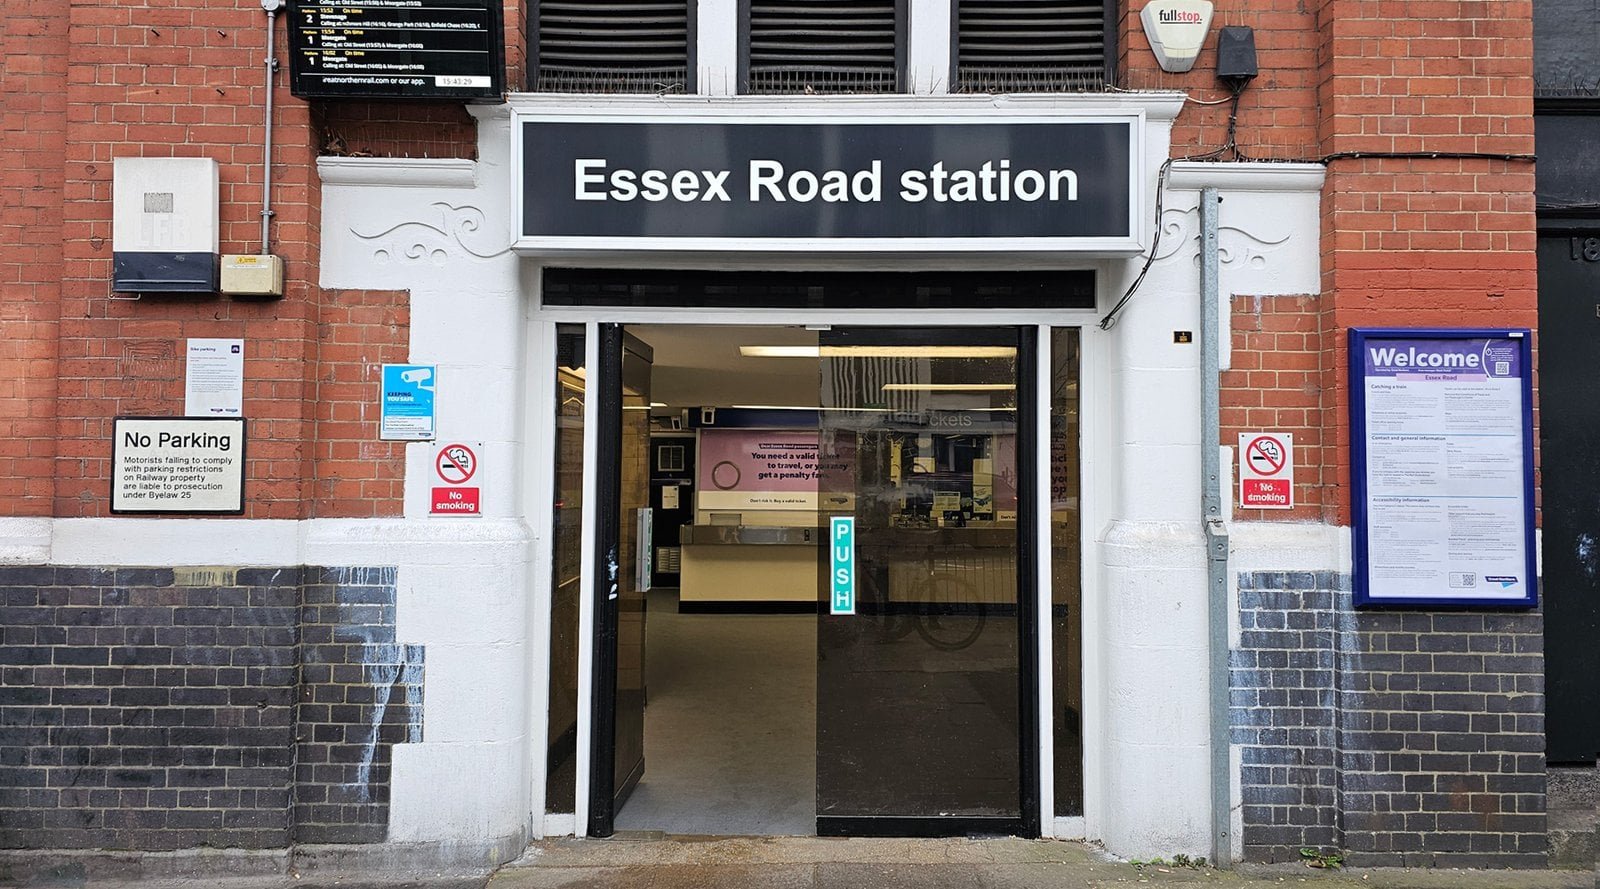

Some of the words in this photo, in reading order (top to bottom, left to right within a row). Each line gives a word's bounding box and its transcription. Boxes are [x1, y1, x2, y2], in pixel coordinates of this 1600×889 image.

[306, 15, 313, 23] 2
[1159, 9, 1202, 24] fullstop.
[307, 35, 313, 44] 1
[308, 57, 314, 65] 1
[574, 159, 731, 202] Essex
[749, 160, 882, 202] Road
[899, 159, 1078, 202] station
[1370, 347, 1479, 367] Welcome
[125, 432, 151, 448] No
[158, 432, 230, 451] Parking
[124, 456, 162, 464] Motorists
[165, 456, 189, 465] failing
[203, 457, 232, 465] comply
[777, 462, 803, 470] travel,
[136, 474, 167, 482] Railway
[170, 474, 205, 482] property
[780, 472, 810, 480] penalty
[174, 483, 223, 491] prosecution
[1260, 483, 1273, 491] No
[149, 491, 178, 500] Byelaw
[449, 491, 462, 499] No
[1247, 493, 1286, 503] smoking
[436, 501, 474, 511] smoking
[836, 524, 849, 607] PUSH
